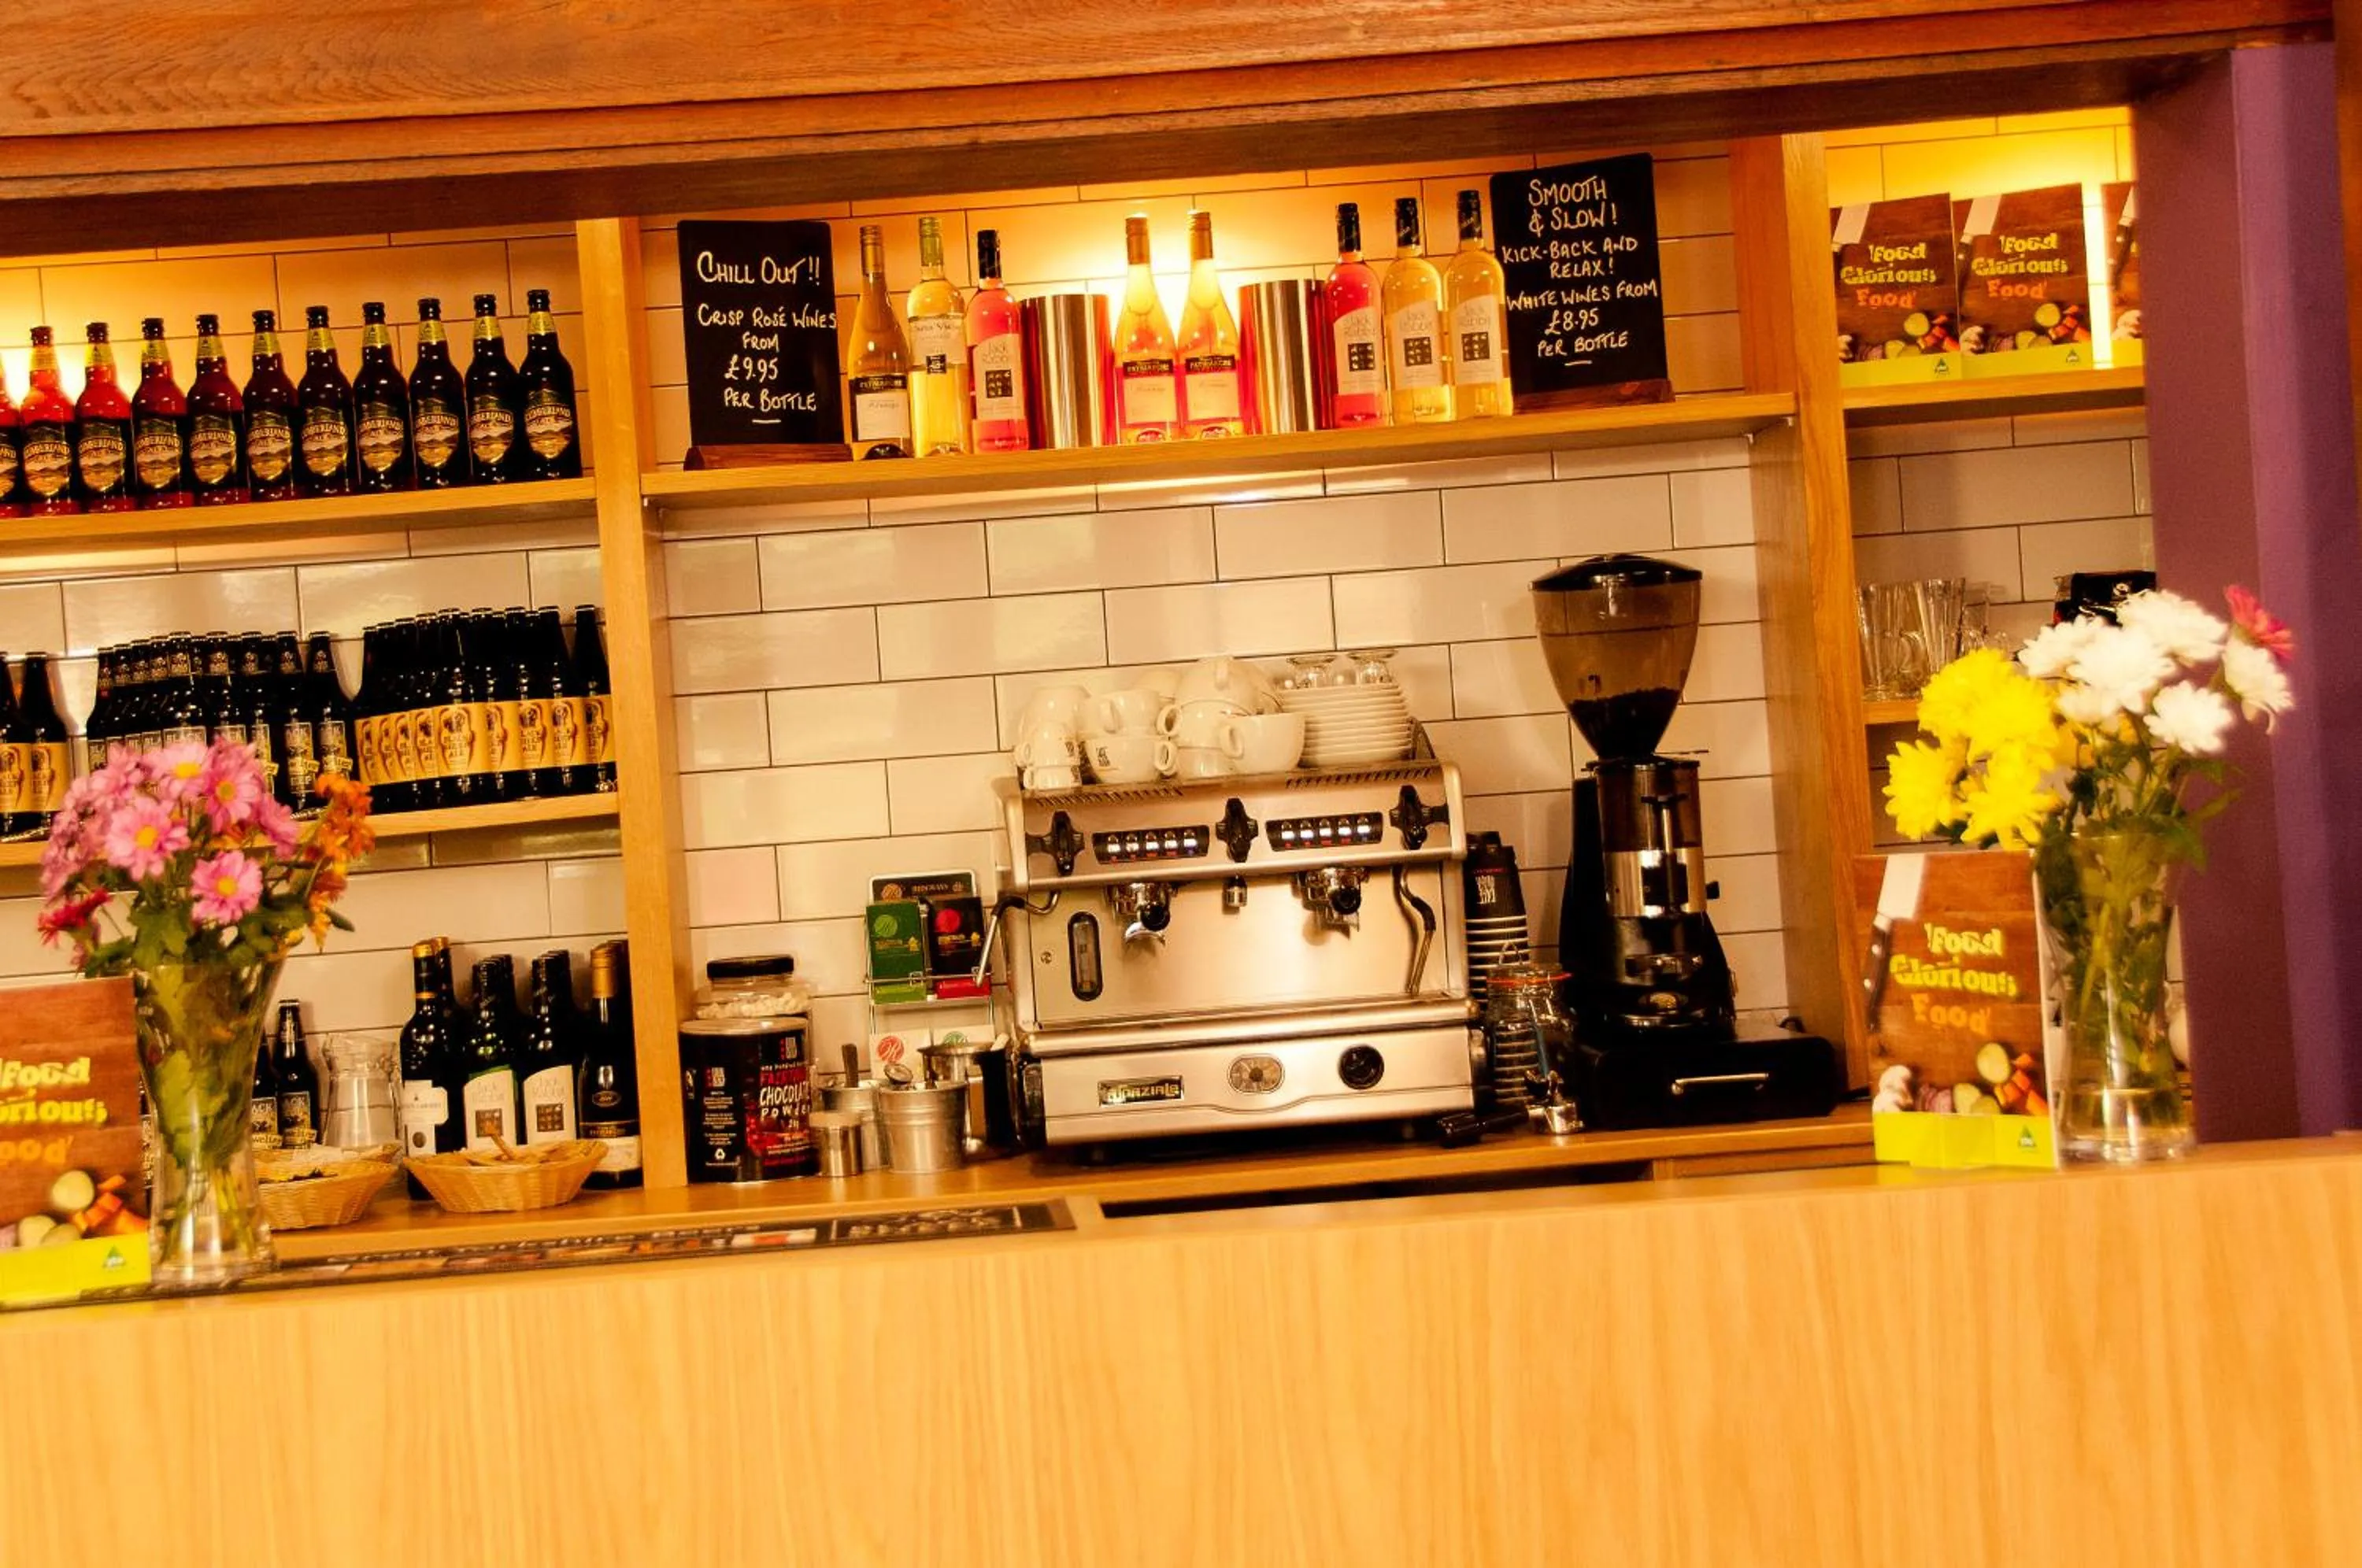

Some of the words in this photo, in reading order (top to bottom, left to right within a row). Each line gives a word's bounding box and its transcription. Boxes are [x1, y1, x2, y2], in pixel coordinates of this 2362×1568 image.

[1528, 176, 1607, 207] SMOOTH
[1528, 209, 1544, 237] &
[1501, 239, 1597, 264] KICK-BACK
[1603, 235, 1638, 253] AND
[698, 251, 755, 284] CHILL
[1840, 263, 1938, 285] Glorious
[1971, 253, 2068, 276] Glorious
[1506, 290, 1558, 312] WHITE
[1560, 285, 1611, 305] WINES
[1616, 279, 1659, 299] FROM
[698, 303, 744, 327] CRISP
[753, 305, 787, 327] ROSÉ
[792, 302, 837, 329] WINES
[1544, 308, 1600, 336] £8.95
[742, 331, 779, 353] FROM
[1575, 331, 1628, 353] BOTTLE
[724, 354, 779, 383] £9.95
[724, 386, 755, 409] PER
[760, 389, 817, 412] BOTTLE
[1890, 953, 2018, 998] Glorious
[252, 1101, 272, 1115] ACK
[0, 1134, 74, 1166] ood
